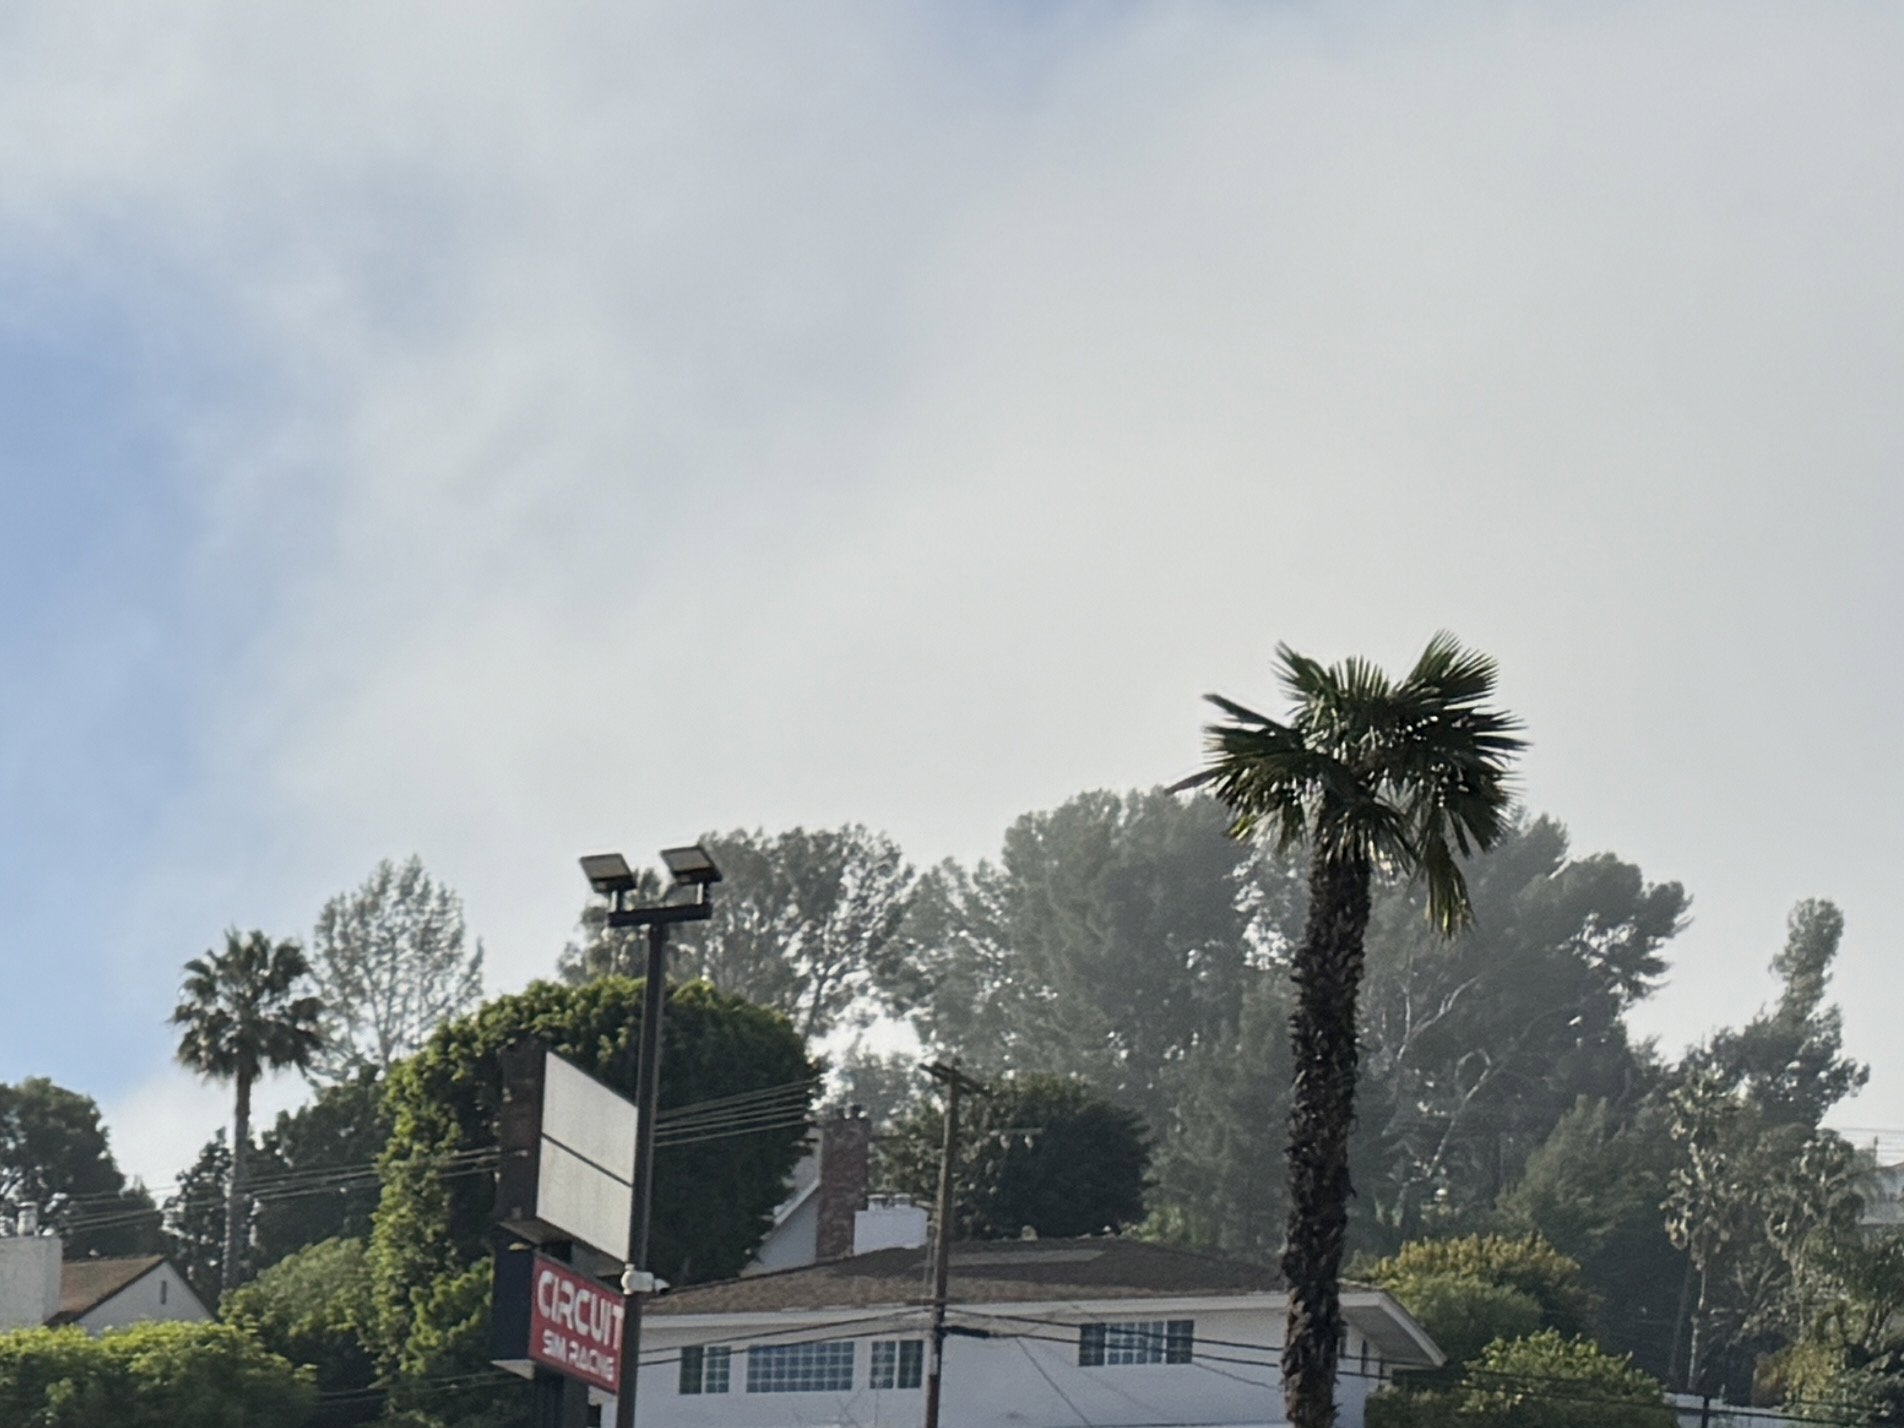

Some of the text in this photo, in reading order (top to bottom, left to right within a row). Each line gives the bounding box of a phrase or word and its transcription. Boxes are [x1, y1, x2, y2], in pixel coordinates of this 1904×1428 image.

[538, 1270, 624, 1350] CIRCUIT
[543, 1329, 614, 1382] SIM RACING
